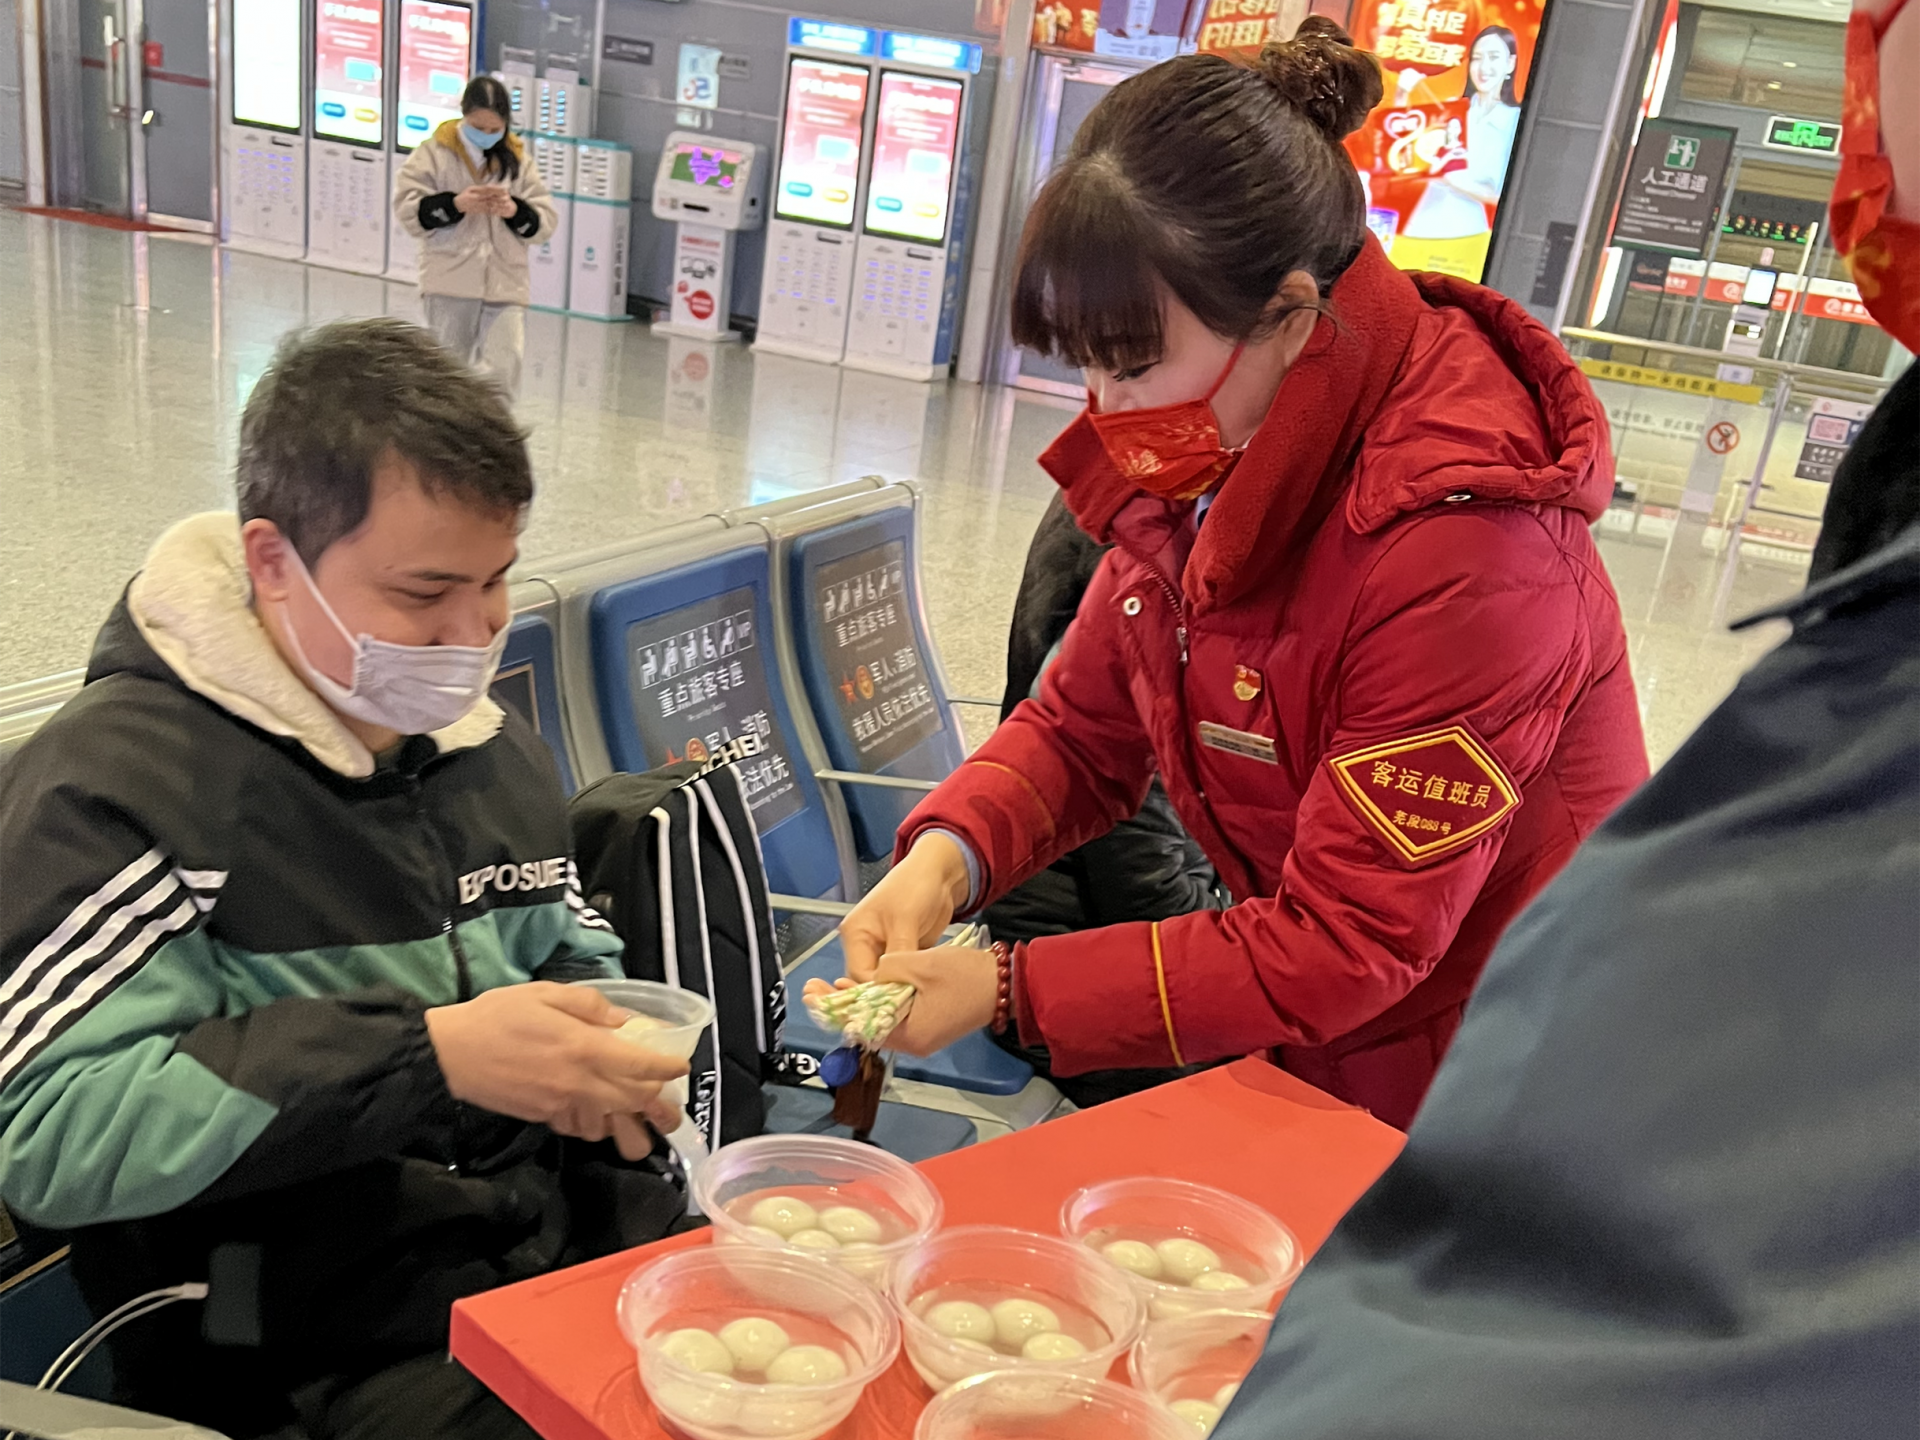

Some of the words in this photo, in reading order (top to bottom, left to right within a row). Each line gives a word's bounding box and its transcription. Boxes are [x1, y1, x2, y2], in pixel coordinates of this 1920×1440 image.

[1640, 166, 1709, 193] 人工通道
[835, 603, 898, 647] 重点旅客专座
[869, 647, 917, 685] 军人、消防
[658, 660, 746, 718] 重点旅客专座
[1371, 760, 1492, 809] 客运值班员
